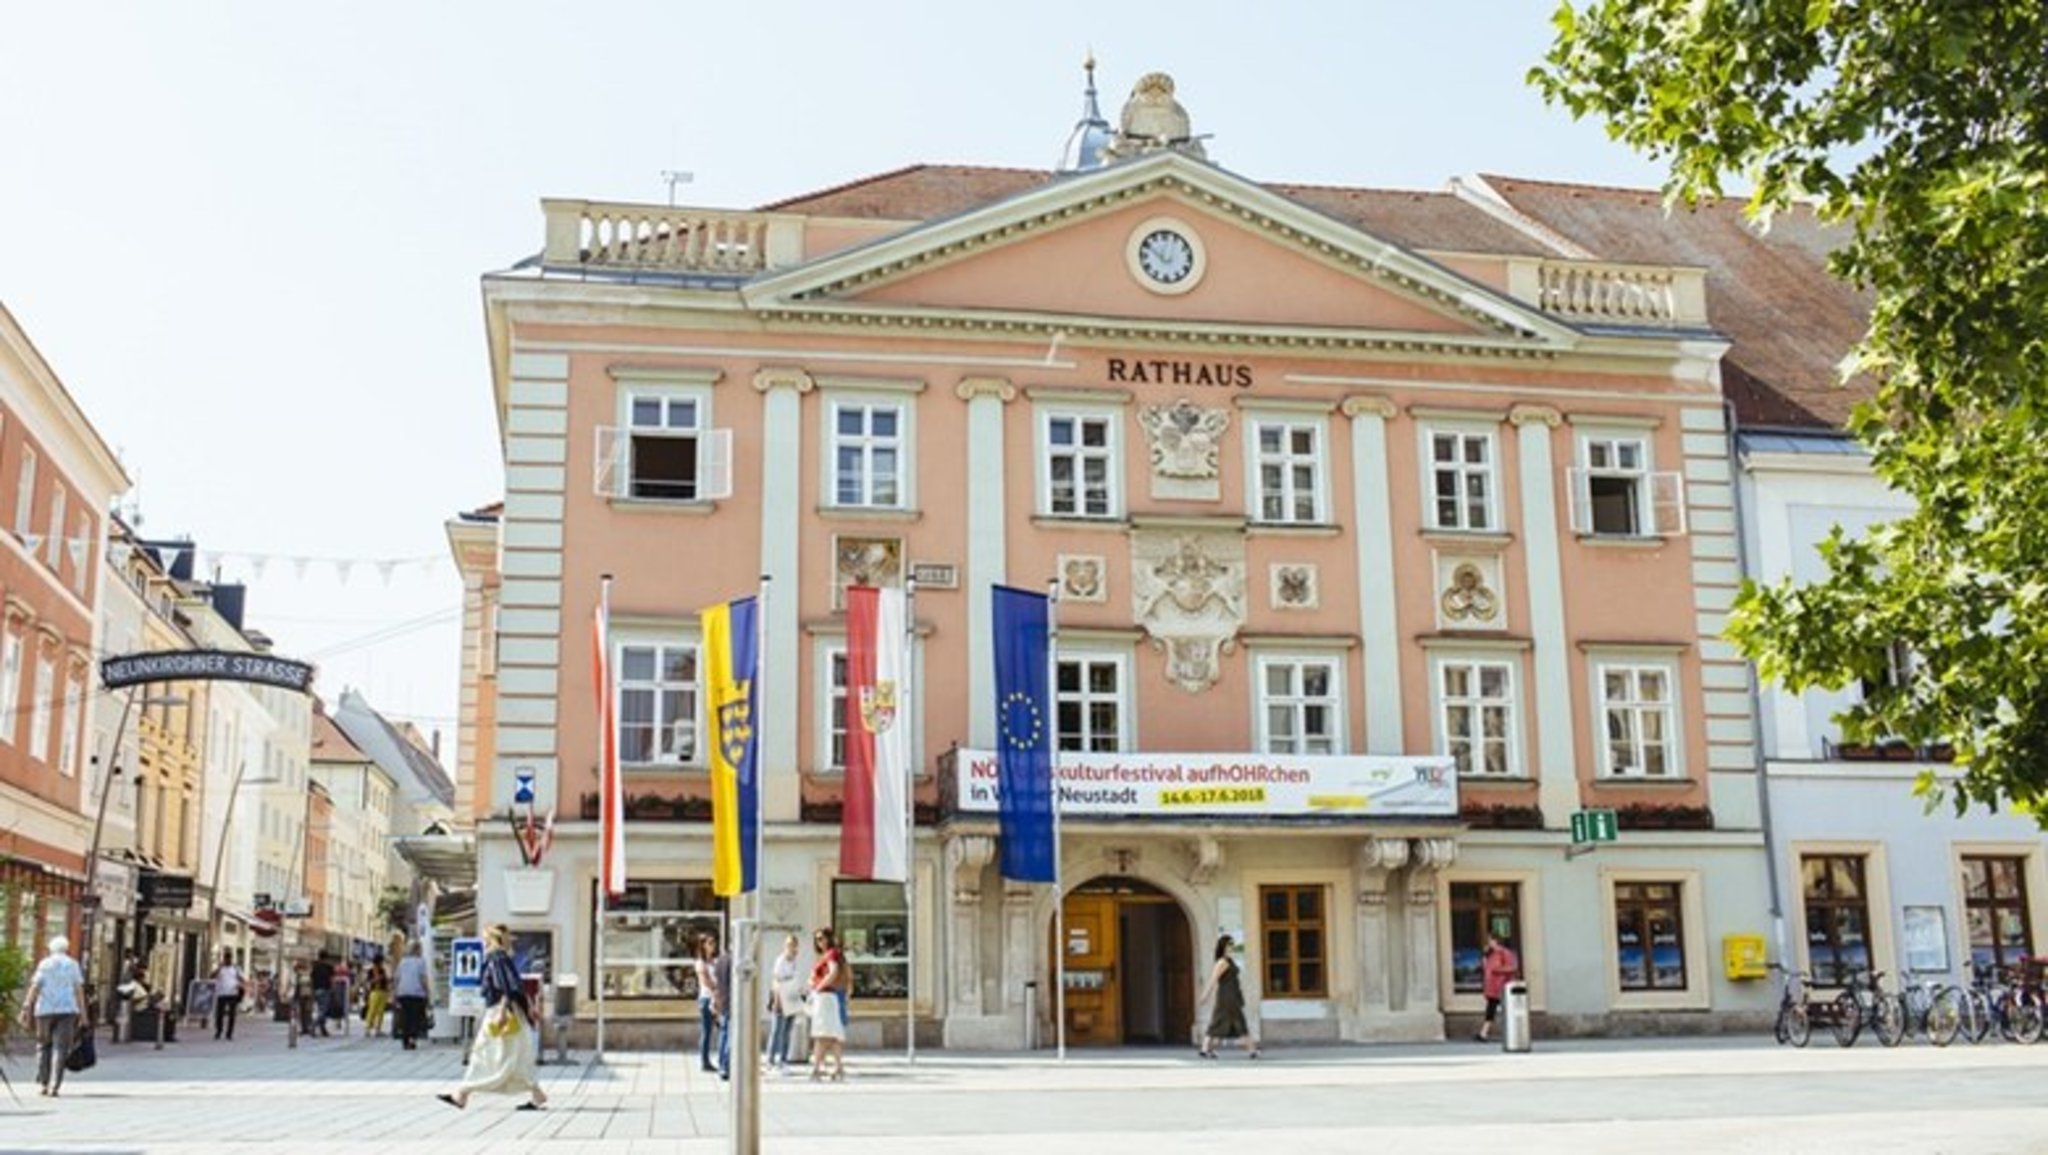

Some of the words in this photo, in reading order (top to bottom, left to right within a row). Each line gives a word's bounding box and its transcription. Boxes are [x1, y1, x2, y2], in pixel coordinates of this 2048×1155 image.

[1107, 358, 1253, 388] RATHAUS
[105, 654, 226, 681] NEUNKIRCHNER
[232, 656, 308, 684] STRASSE
[1187, 764, 1311, 784] aufhOHRchen
[970, 787, 988, 801] in
[1058, 787, 1138, 804] Neustadt
[1161, 788, 1264, 805] 14.6.-17.6.2018
